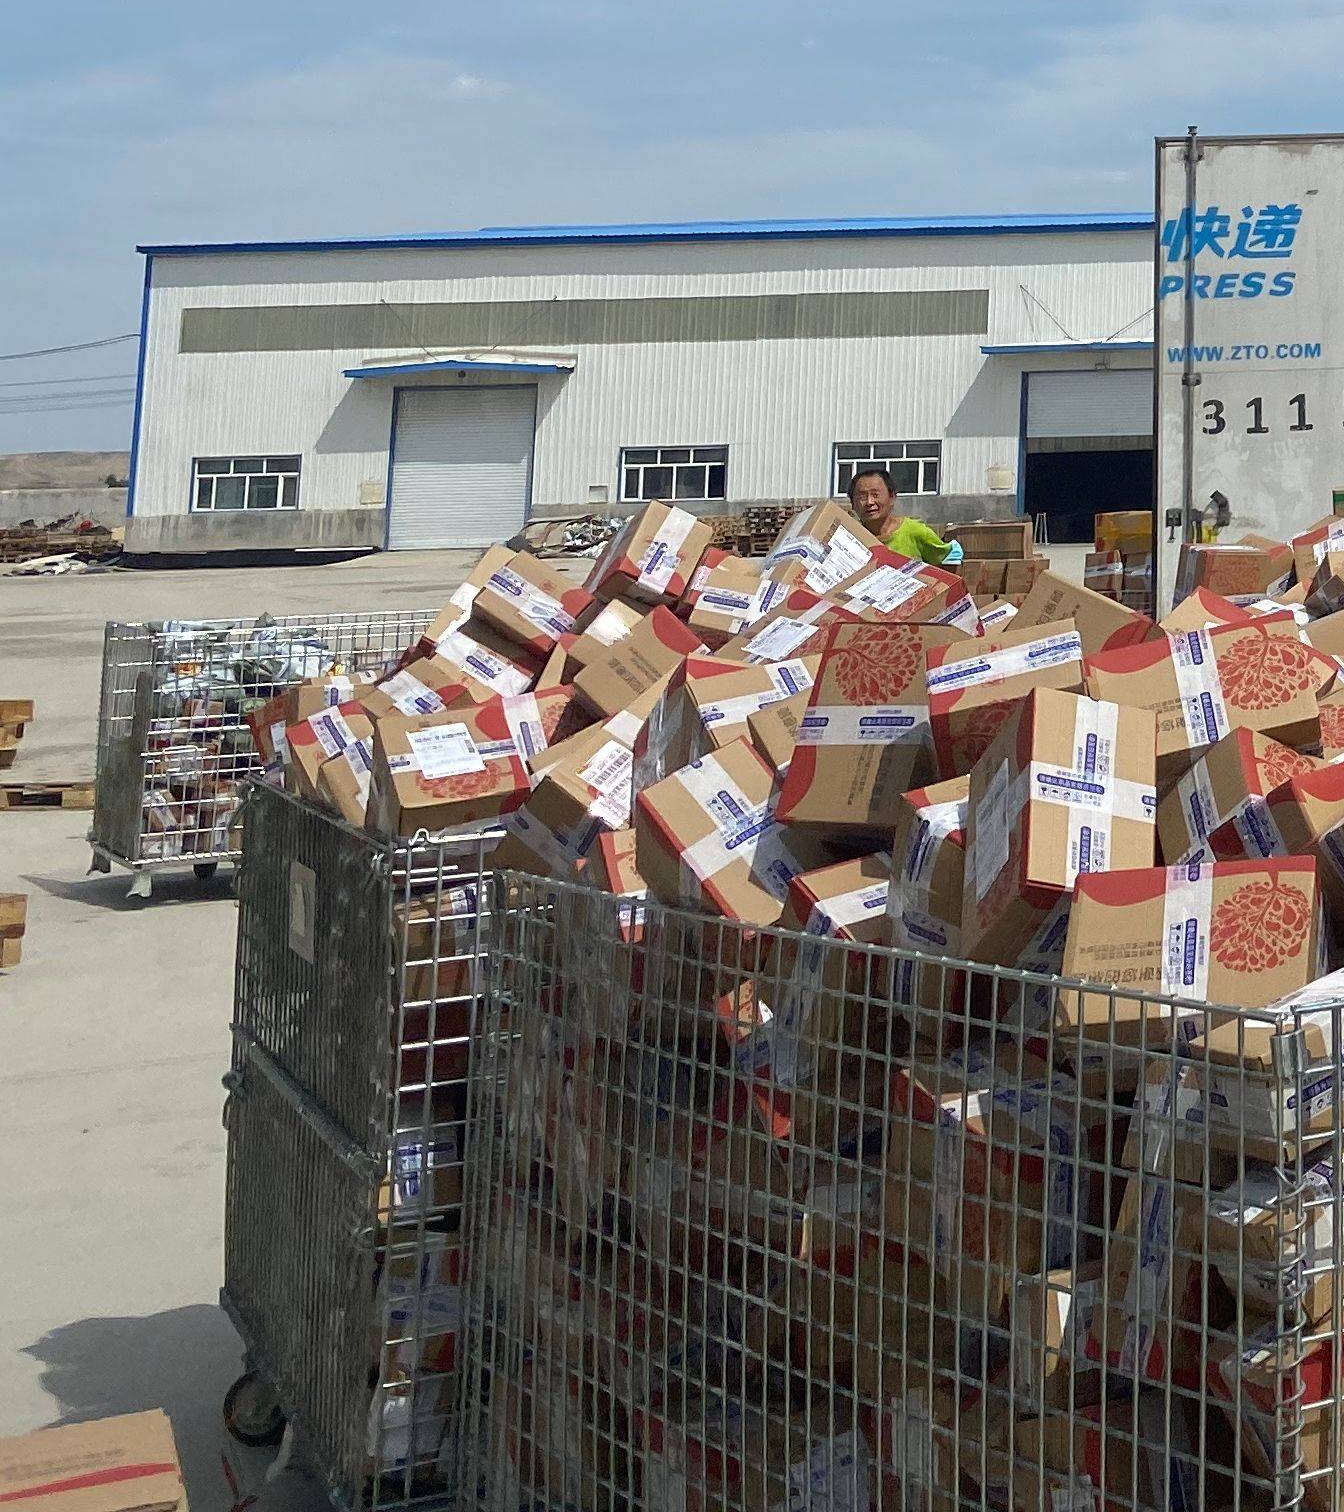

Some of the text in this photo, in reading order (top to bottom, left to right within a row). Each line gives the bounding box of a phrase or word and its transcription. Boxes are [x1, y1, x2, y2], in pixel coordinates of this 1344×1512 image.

[1160, 203, 1302, 262] 快递
[1159, 271, 1296, 300] PRESS
[1167, 343, 1322, 363] WWW.ZTO.COM
